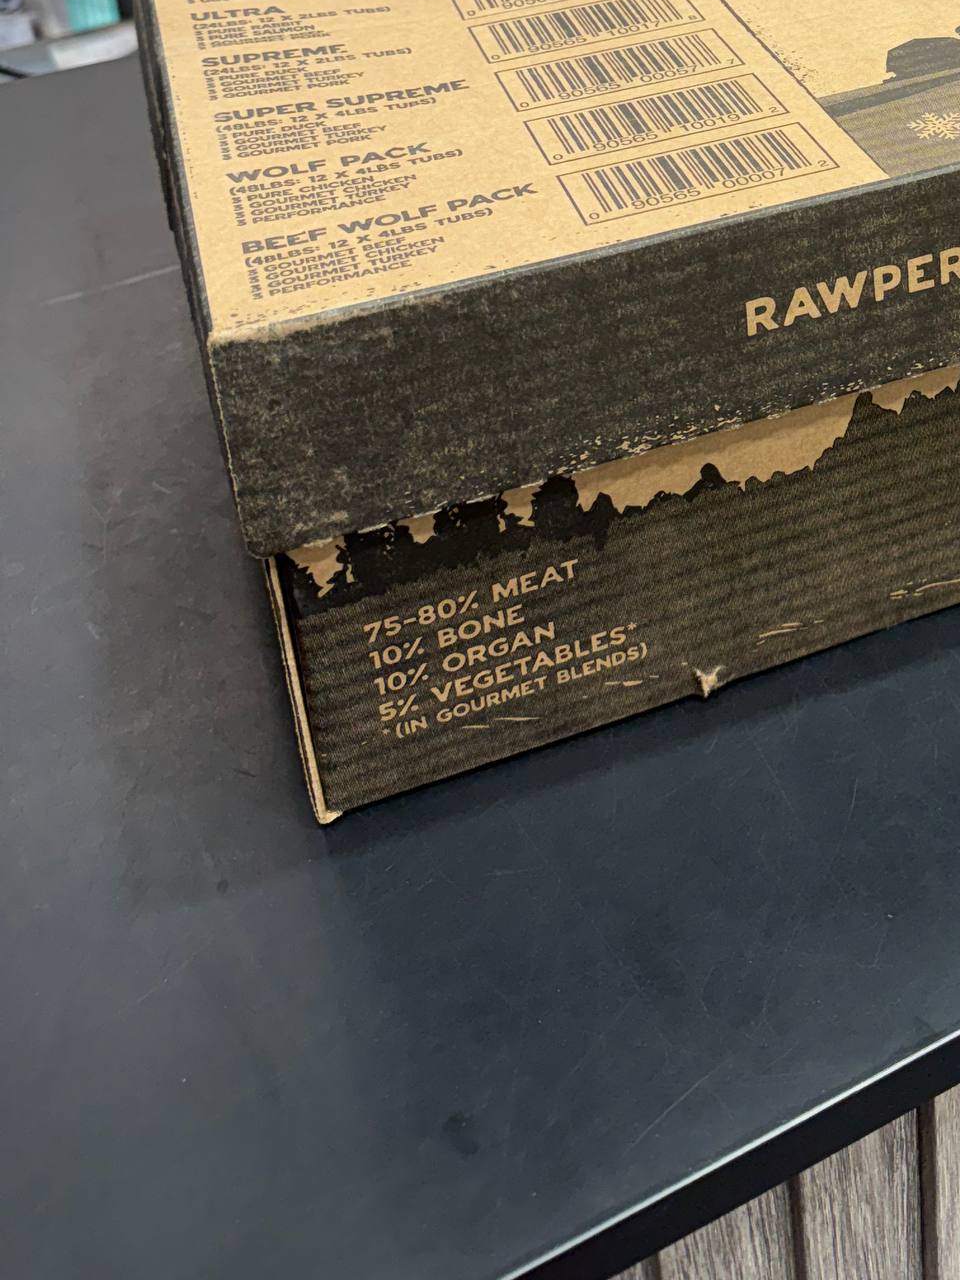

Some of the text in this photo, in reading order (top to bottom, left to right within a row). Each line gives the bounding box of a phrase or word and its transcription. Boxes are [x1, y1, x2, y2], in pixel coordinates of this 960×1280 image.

[191, 5, 284, 21] ULTRA
[344, 6, 390, 14] TUBS)
[254, 25, 315, 35] SALMON
[528, 36, 587, 52] 90565
[607, 21, 662, 35] 10017
[202, 43, 347, 67] SUPREME
[265, 67, 307, 76] DUCK
[316, 55, 356, 64] 2LBS
[363, 48, 412, 58] TUBS)
[221, 73, 299, 86] GOURMET
[222, 72, 364, 92] GOURMET TURKEY
[224, 79, 349, 98] GOURMET PORK
[558, 82, 620, 99] 90565
[639, 65, 700, 82] 00057
[214, 79, 469, 122] SUPER SUPREME
[216, 118, 282, 132] (48LBS:
[290, 115, 308, 123] 12
[336, 106, 378, 117] 4LBS
[385, 97, 436, 109] TUBS)
[233, 121, 325, 138] PURE DUCK
[235, 122, 361, 144] GOURMET BEEF
[236, 125, 387, 151] GOURMET TURKEY
[238, 134, 370, 158] GOURMET PORK
[593, 131, 658, 150] 90565
[679, 114, 741, 131] 10019
[227, 142, 430, 184] WOLF PACK
[230, 149, 462, 195] (48LBS: 12 X 4LBS TUBS)
[247, 176, 374, 201] PURE CHICKEN
[250, 174, 416, 209] GOURMET CHICKEN
[252, 182, 410, 216] GOURMET TURKEY
[587, 159, 830, 220] 0 90565 00007 2
[242, 183, 537, 254] BEEF WOLF PACK
[252, 194, 386, 224] PERFORMANCE
[245, 208, 493, 267] (48LBS: 12 X 4LBS TUBS)
[264, 237, 406, 273] GOURMET BEEF
[266, 236, 444, 280] GOURMET CHICKEN
[268, 245, 437, 288] GOURMET TURKEY
[269, 260, 411, 296] PERFORMANCE
[363, 559, 579, 644] 75-80% MEAT
[369, 604, 525, 670] 10% BONE
[373, 622, 556, 696] 10% ORGAN
[436, 676, 548, 723] GOURMET
[556, 642, 648, 685] BLENDS)
[379, 694, 419, 721] 5%
